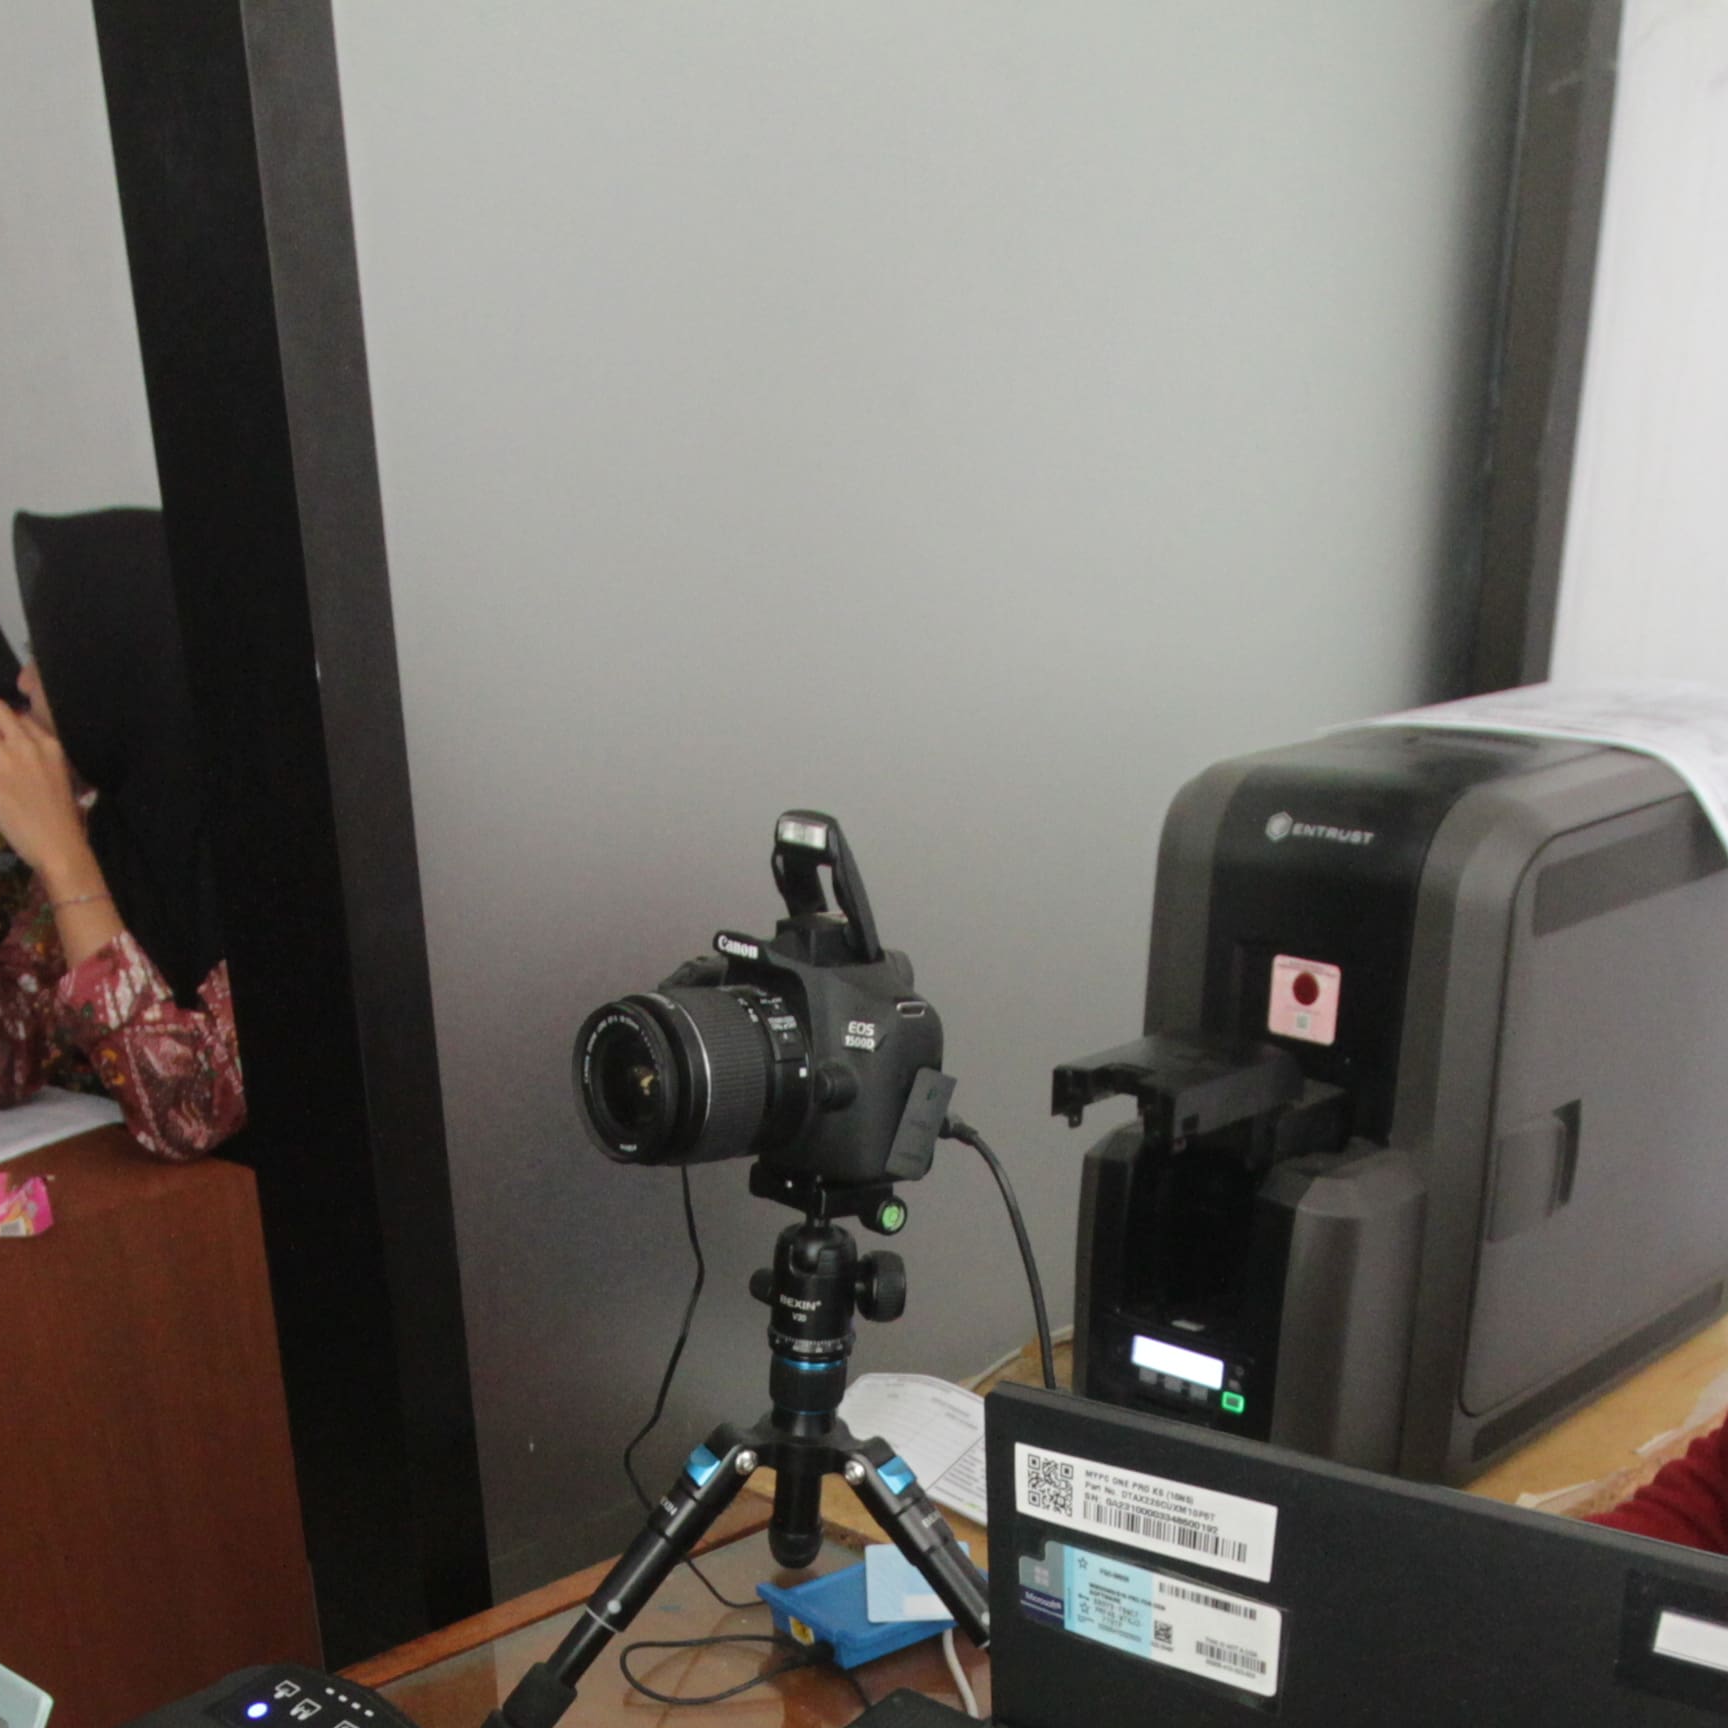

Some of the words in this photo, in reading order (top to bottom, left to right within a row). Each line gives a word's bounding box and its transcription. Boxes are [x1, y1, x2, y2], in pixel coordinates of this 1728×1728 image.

[1291, 822, 1375, 844] ENTRUST
[718, 934, 759, 960] Canon
[848, 1020, 875, 1036] EOS
